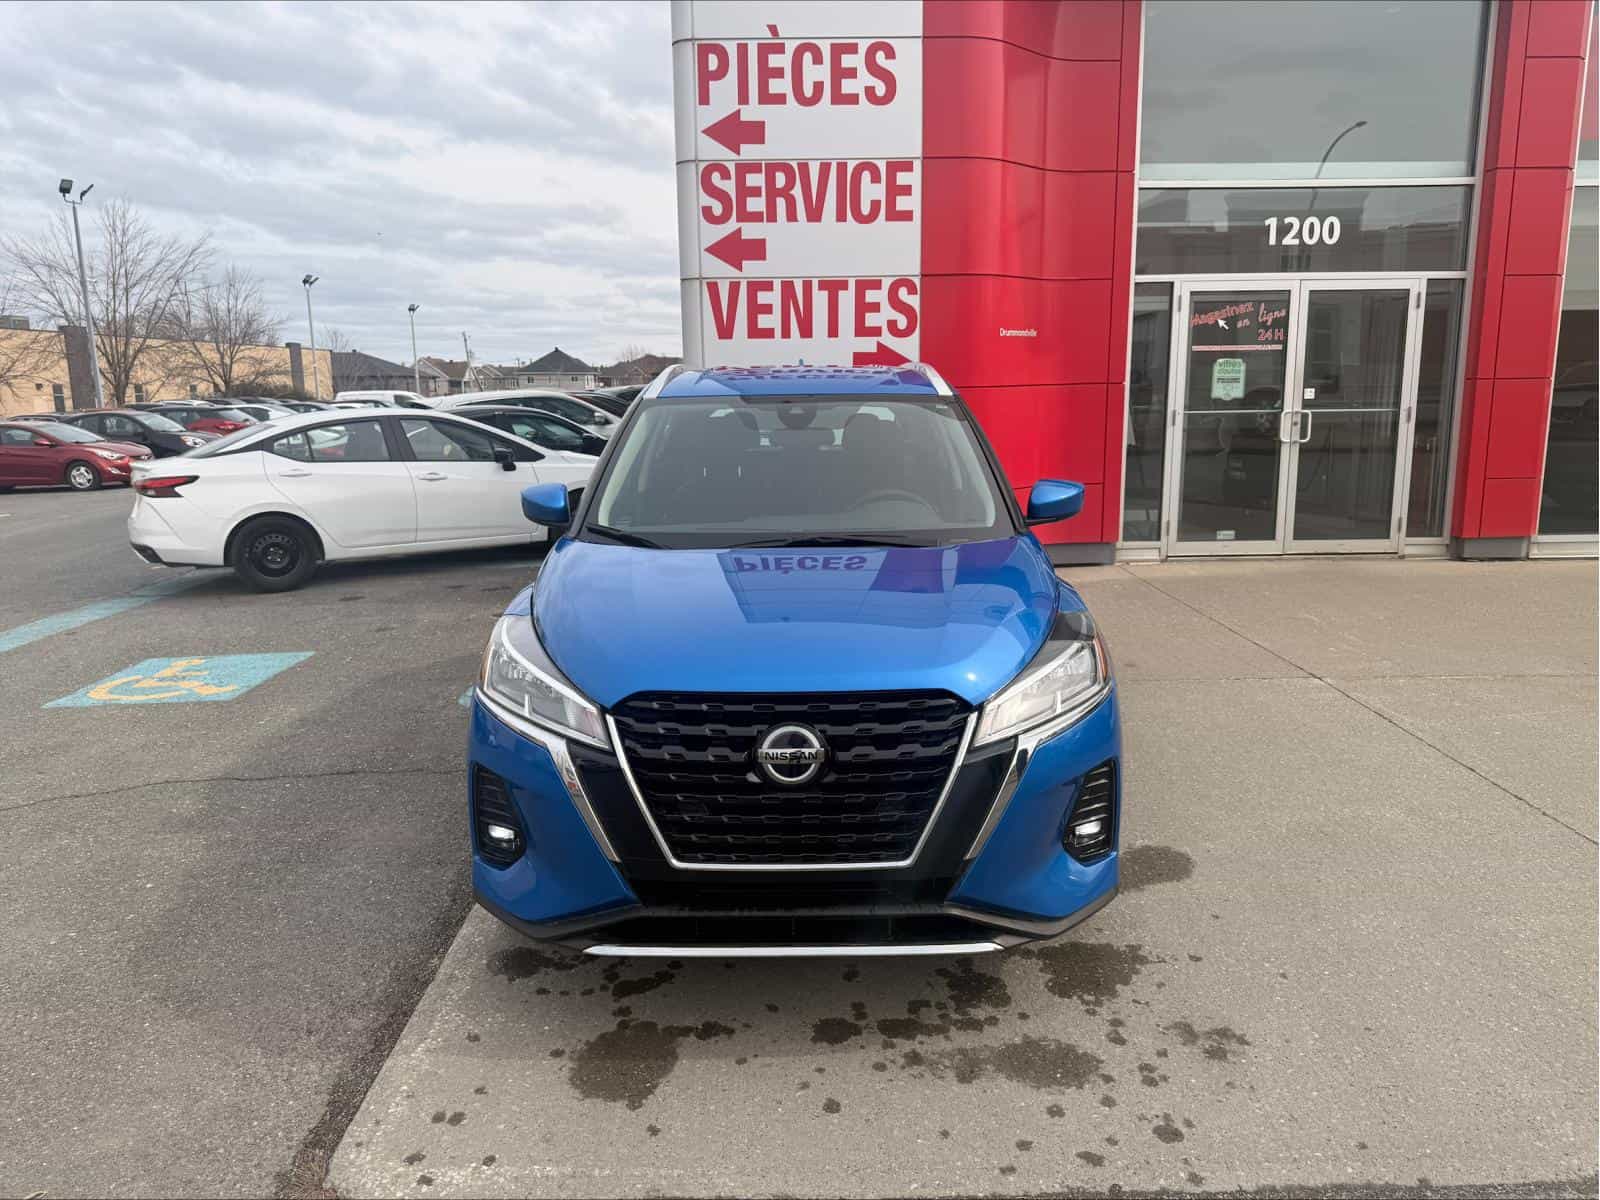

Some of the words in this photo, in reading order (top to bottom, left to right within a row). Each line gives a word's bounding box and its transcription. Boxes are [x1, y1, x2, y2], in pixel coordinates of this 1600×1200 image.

[696, 24, 897, 107] PIÈCES
[700, 161, 914, 225] SERVICE
[1264, 215, 1341, 246] 1200
[705, 277, 919, 340] VENTES
[764, 751, 818, 761] NISSAN
